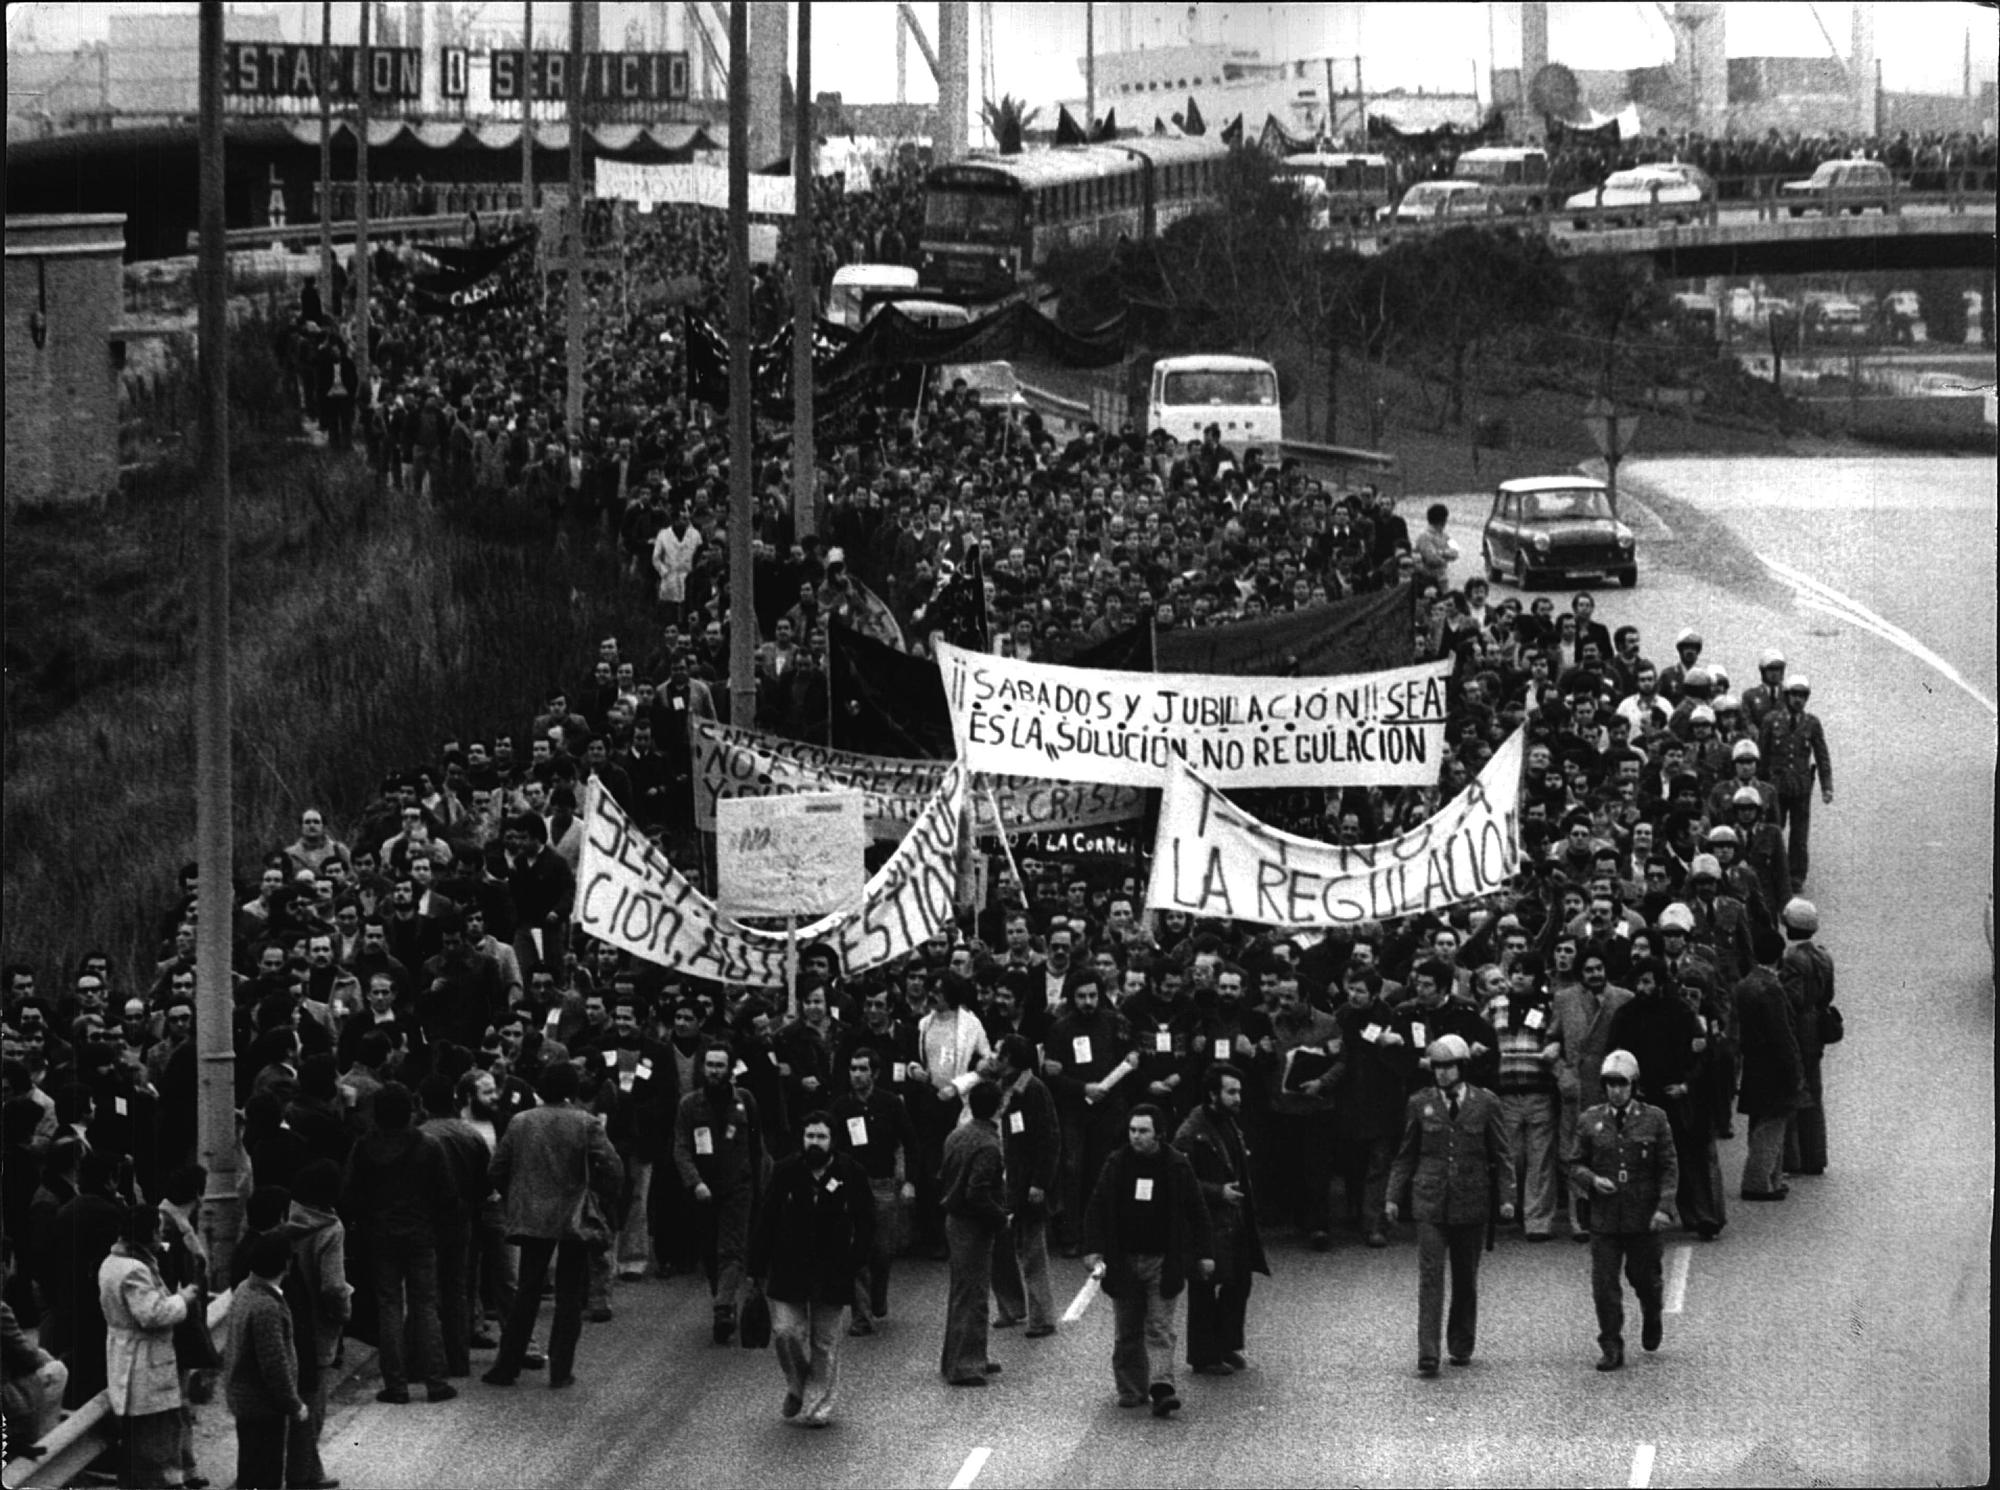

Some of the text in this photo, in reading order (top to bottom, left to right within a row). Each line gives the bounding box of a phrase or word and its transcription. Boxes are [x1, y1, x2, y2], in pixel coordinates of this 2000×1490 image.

[1125, 694, 1142, 723] Y
[1384, 675, 1448, 721] SEAT
[1203, 736, 1245, 770] NO
[1172, 837, 1233, 916] LA
